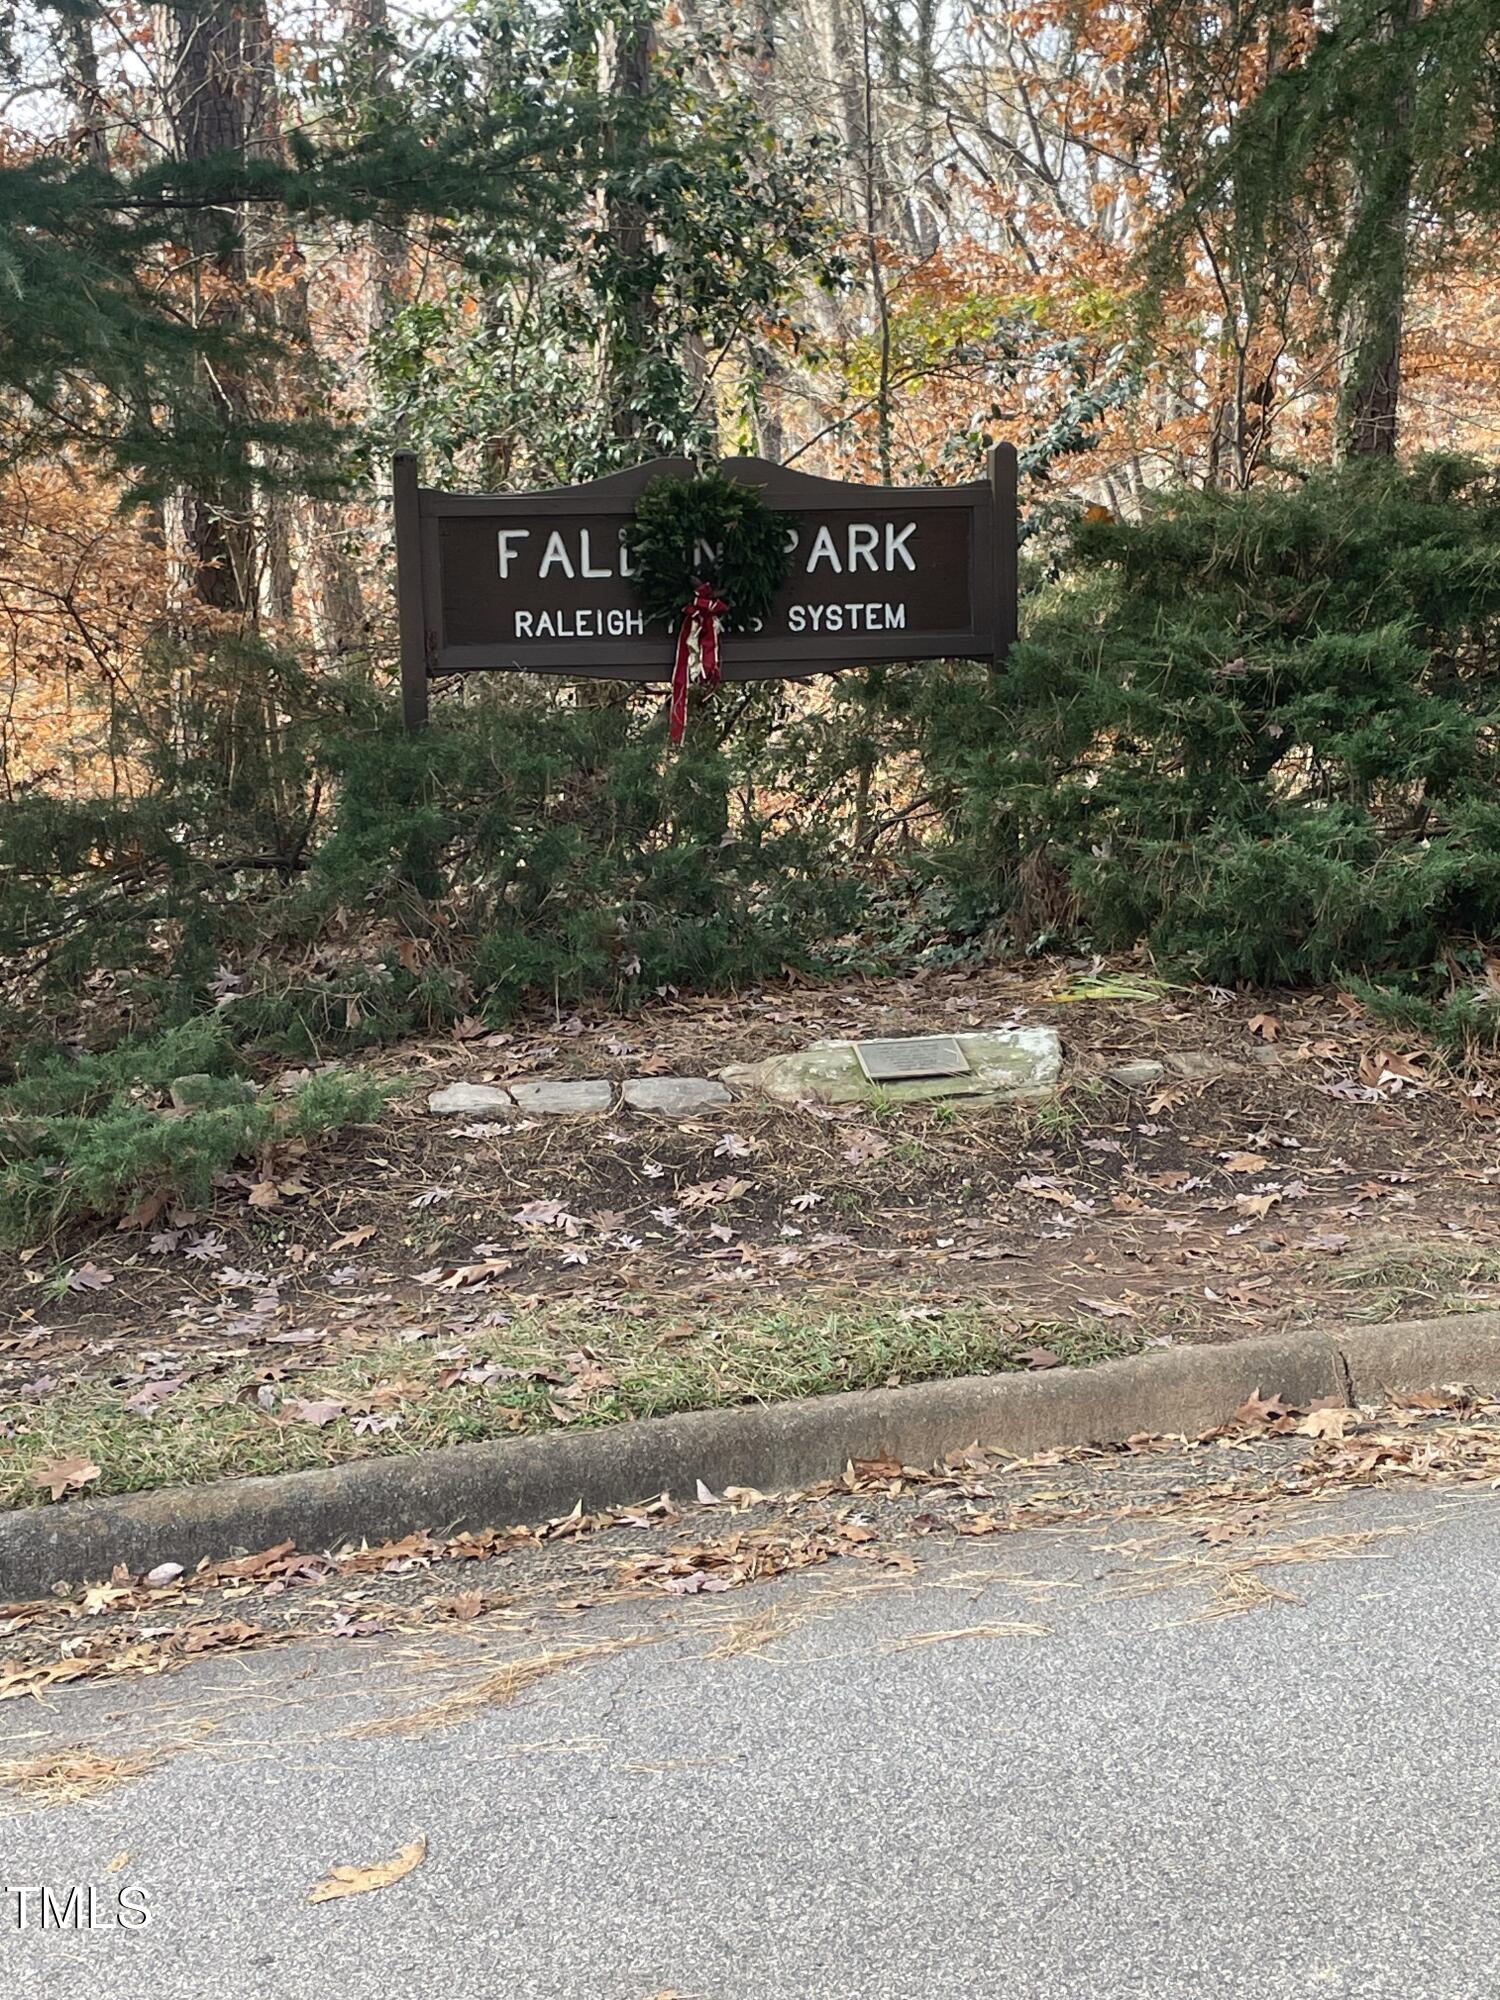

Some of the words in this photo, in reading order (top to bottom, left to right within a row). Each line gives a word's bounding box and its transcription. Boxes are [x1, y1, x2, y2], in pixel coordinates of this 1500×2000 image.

[498, 528, 724, 579] FALLN
[514, 608, 644, 638] RALEIGH
[787, 603, 906, 632] SYSTEM
